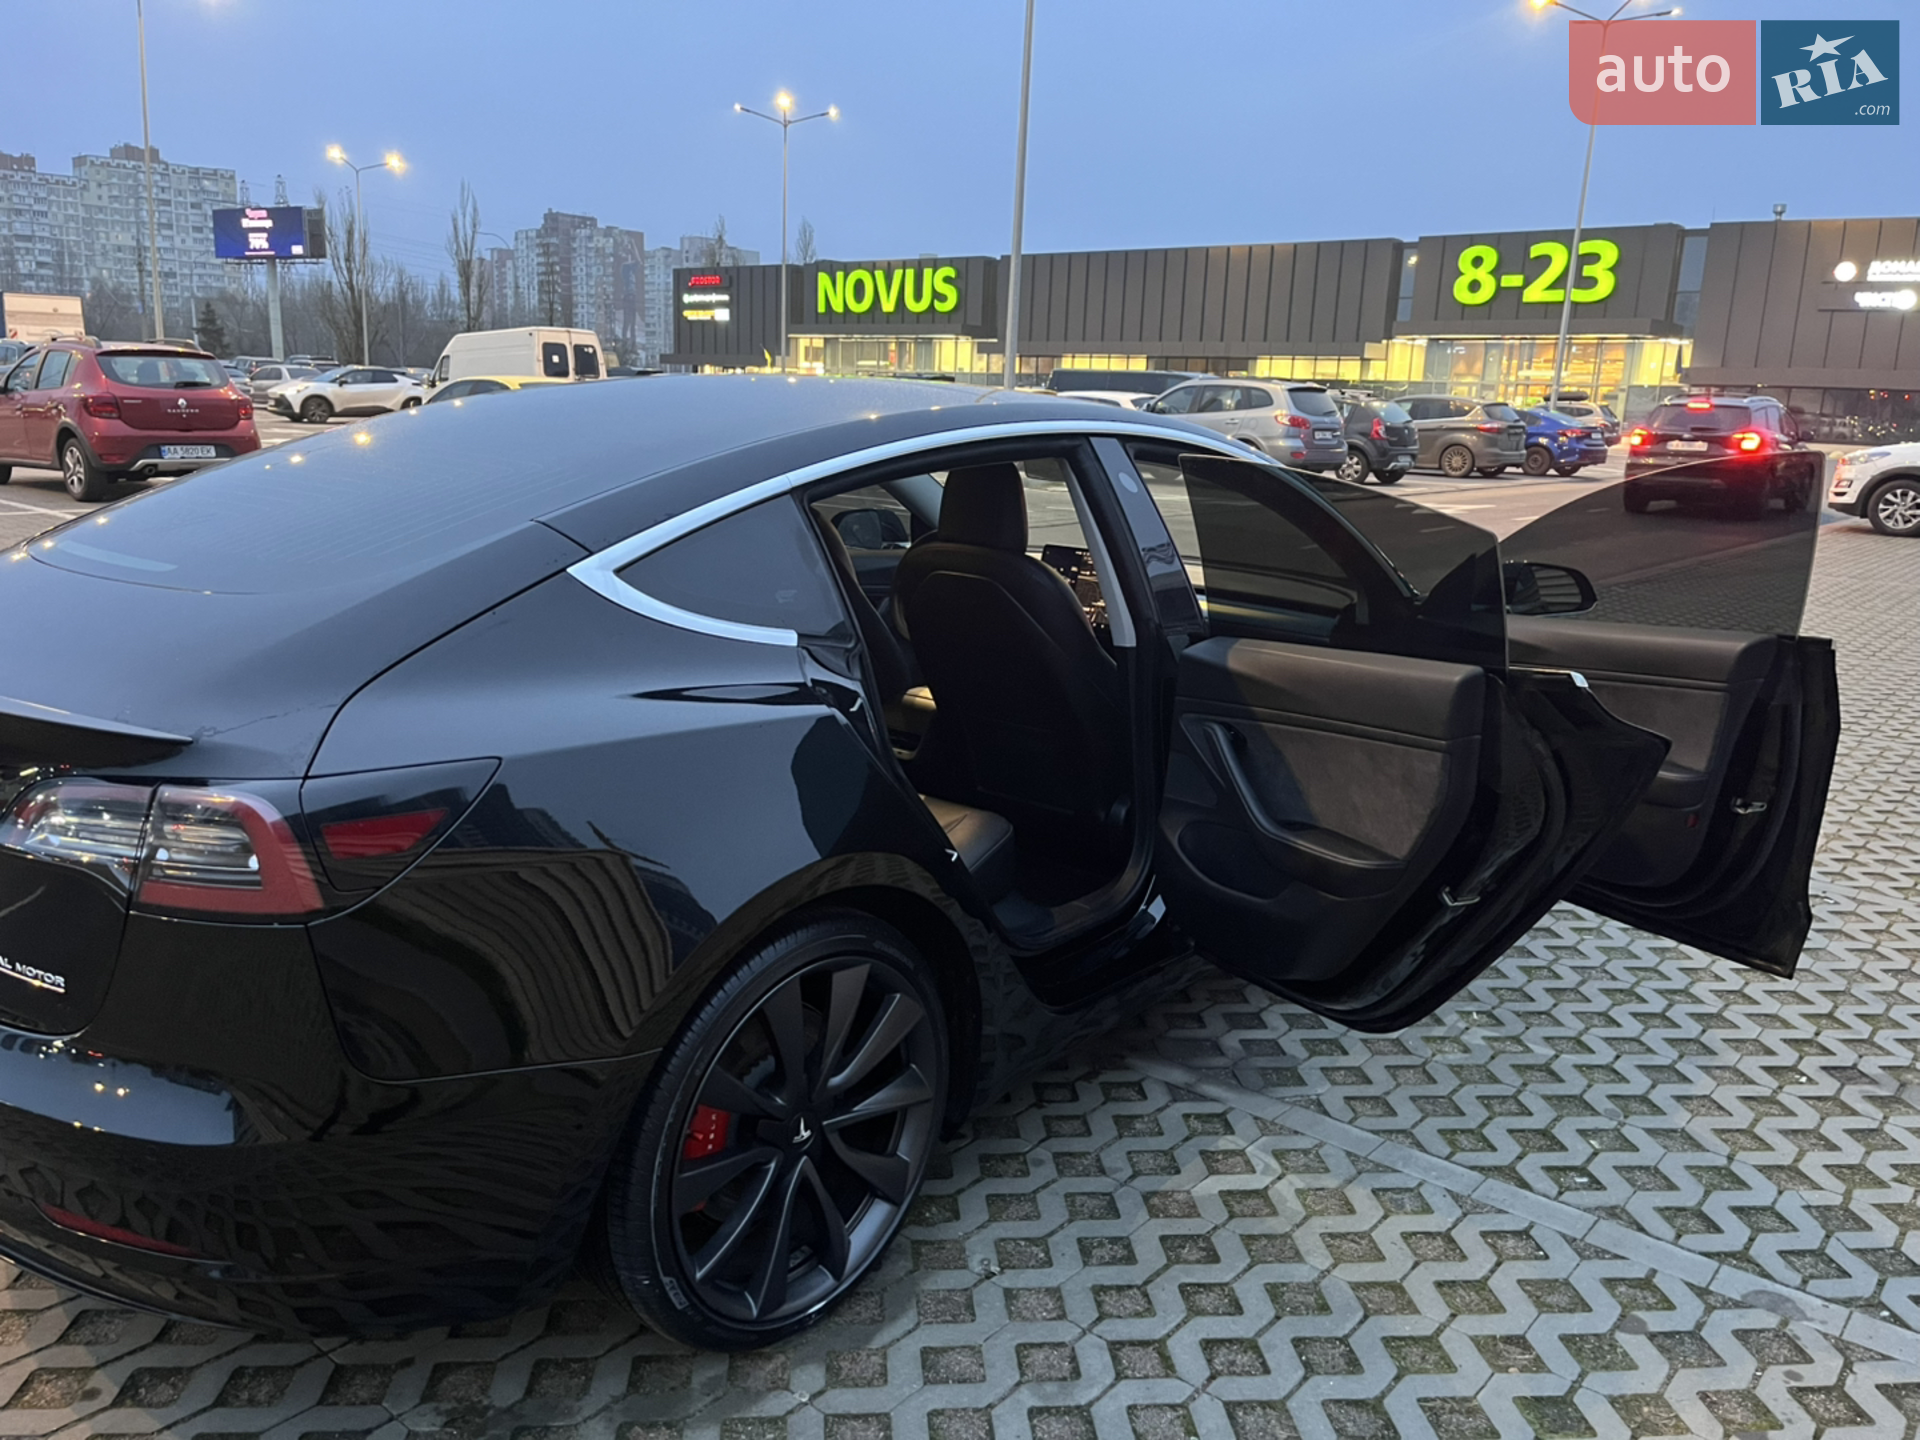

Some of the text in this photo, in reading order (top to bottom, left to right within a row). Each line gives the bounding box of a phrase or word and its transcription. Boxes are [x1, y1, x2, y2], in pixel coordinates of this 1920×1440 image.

[817, 266, 958, 313] NOVUS
[1452, 239, 1619, 305] 8-23
[15, 962, 65, 987] MOTOR
